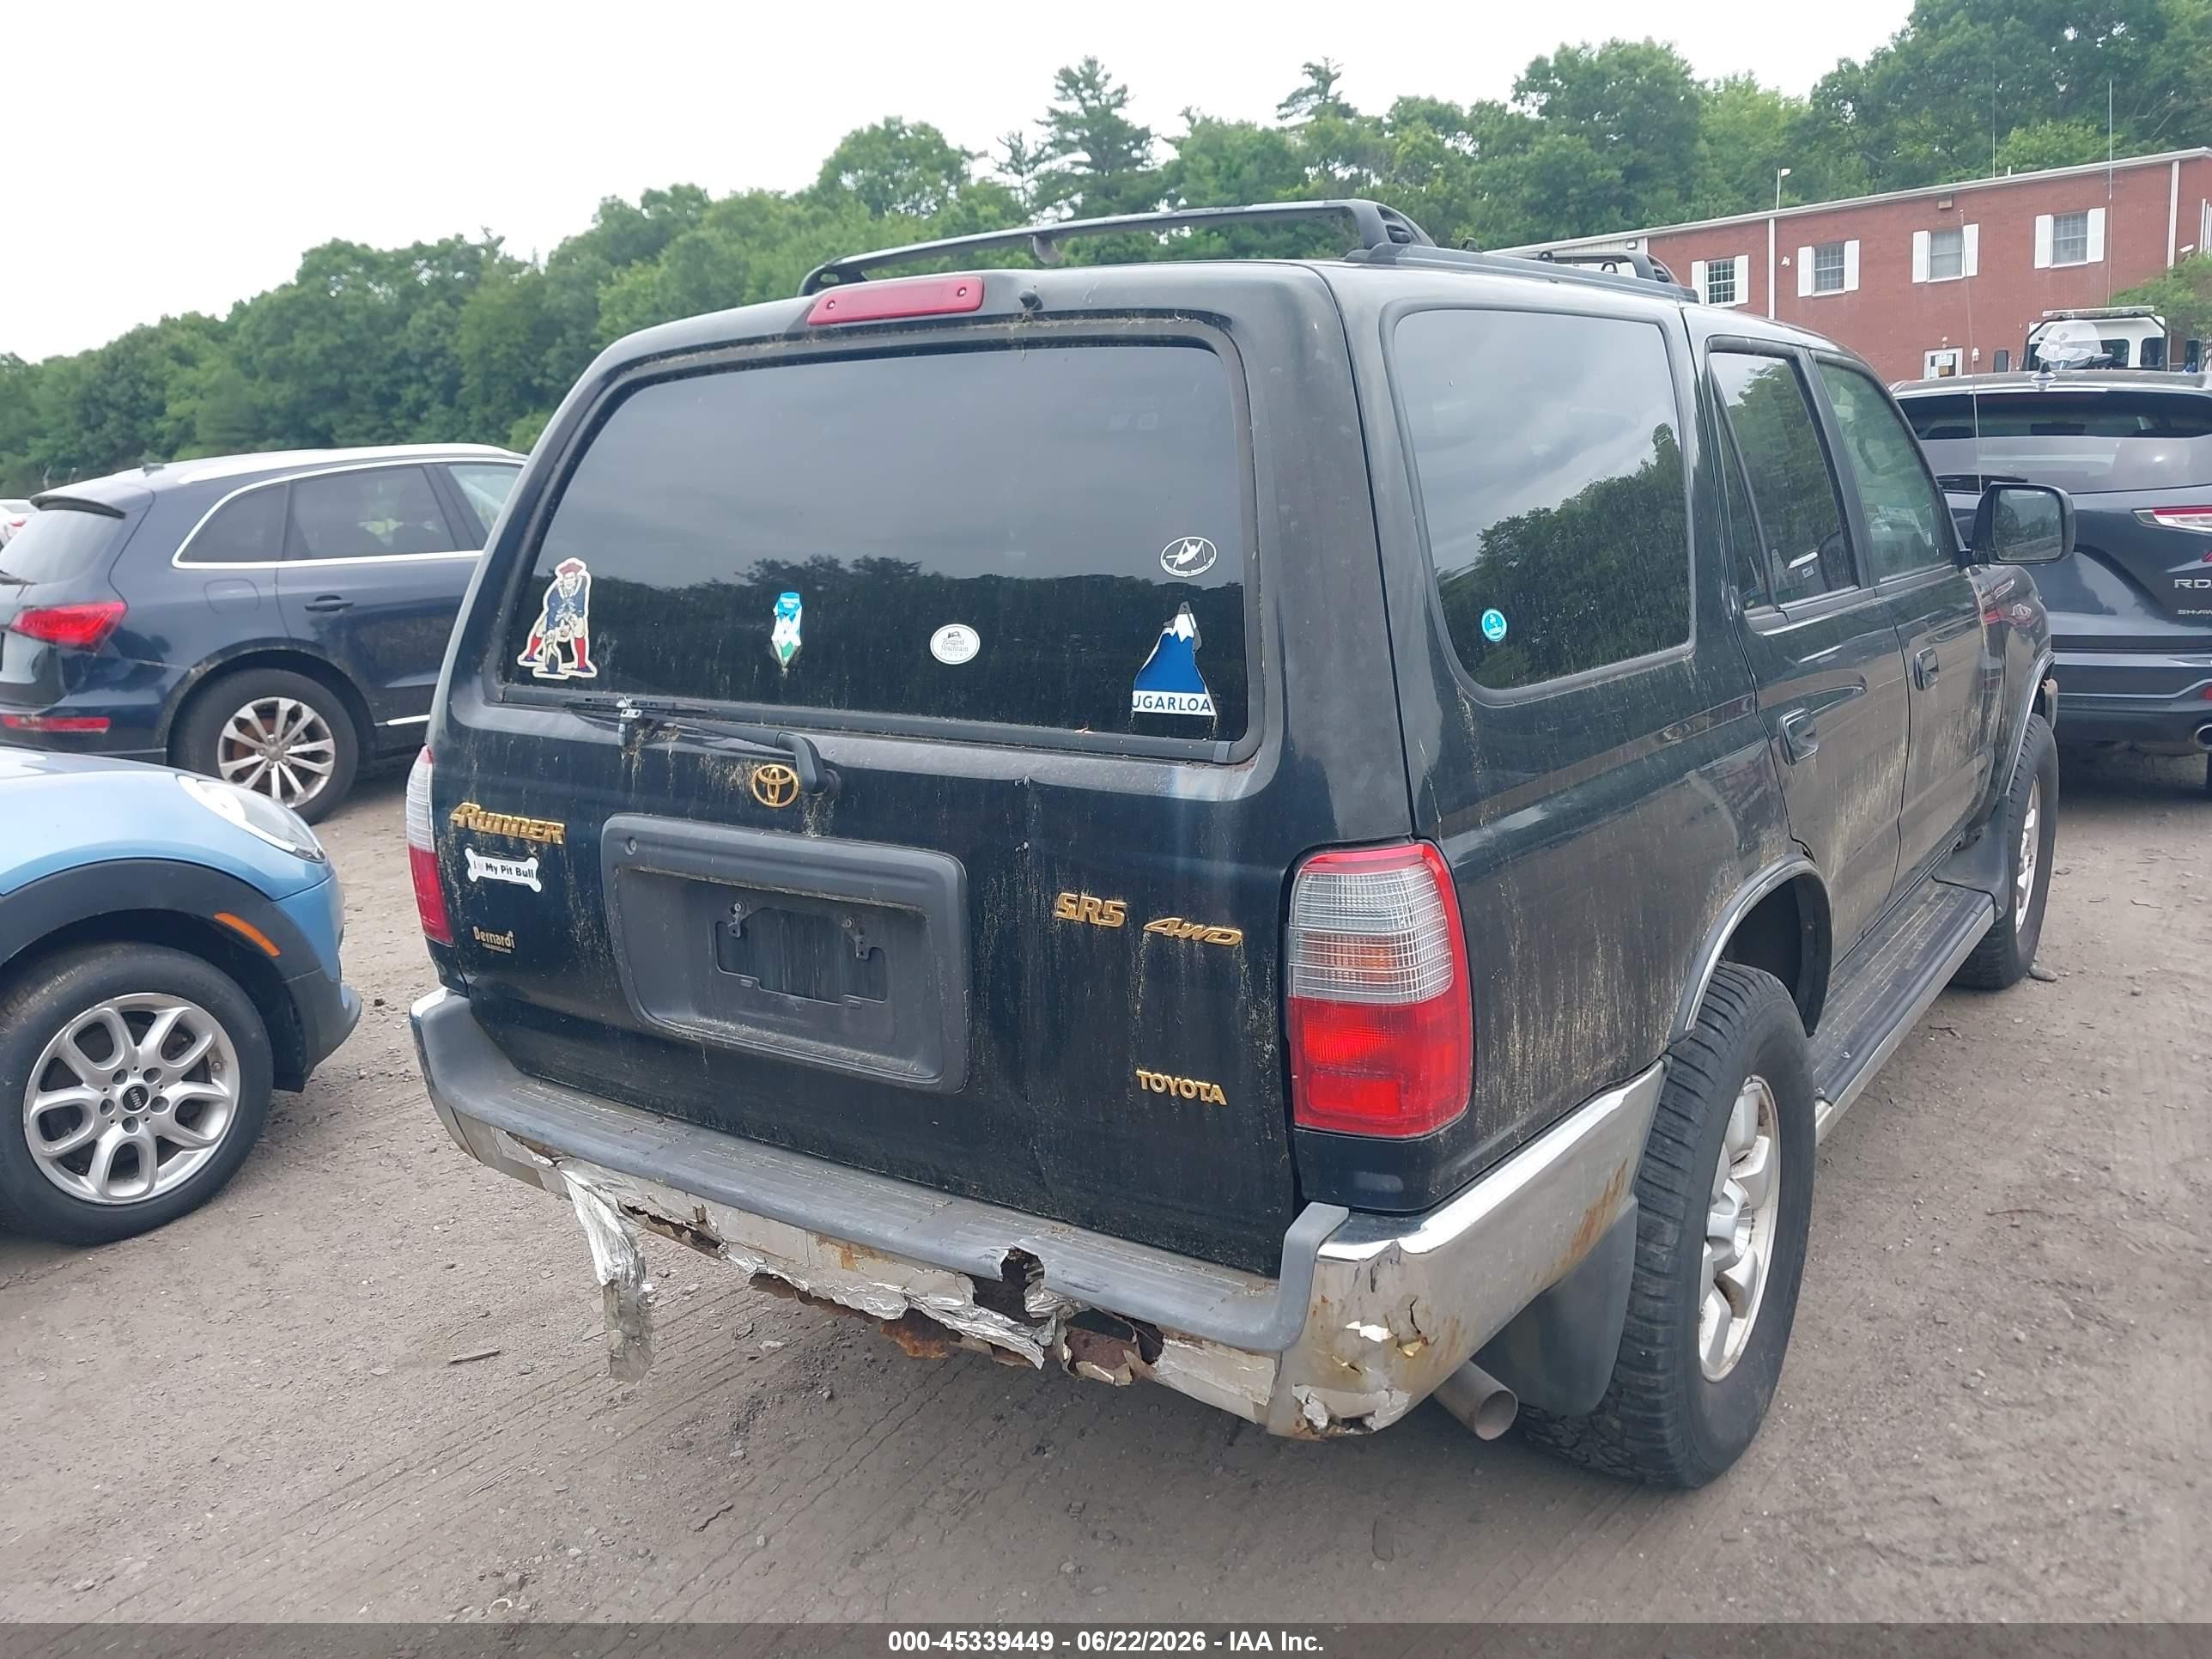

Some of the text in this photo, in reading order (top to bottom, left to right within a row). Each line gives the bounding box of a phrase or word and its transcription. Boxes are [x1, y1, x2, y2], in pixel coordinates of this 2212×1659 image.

[2174, 579, 2212, 589] RD
[485, 862, 498, 876] My
[501, 865, 513, 876] Pit
[515, 867, 534, 879] Bull
[1055, 892, 1243, 946] SR5 4WD
[1136, 1070, 1228, 1106] TOYOTA
